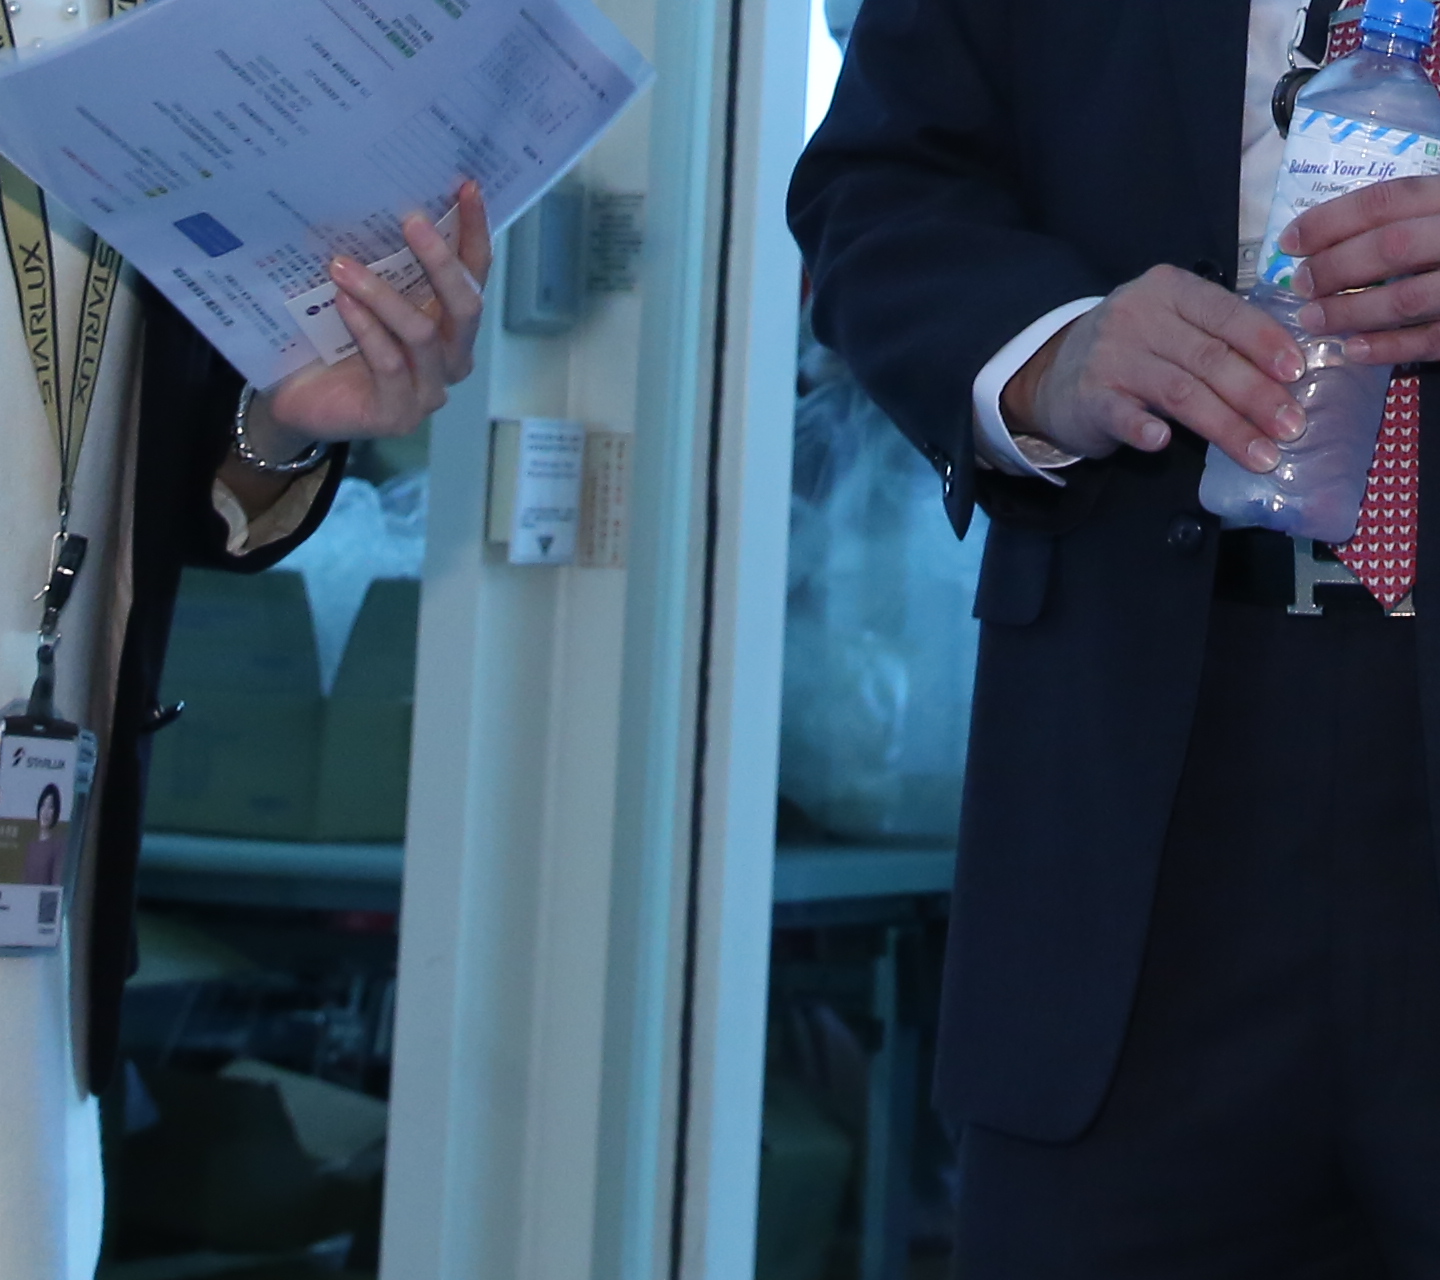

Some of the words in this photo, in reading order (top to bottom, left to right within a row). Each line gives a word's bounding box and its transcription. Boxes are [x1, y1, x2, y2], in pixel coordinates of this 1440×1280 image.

[1289, 158, 1330, 175] Balance
[1331, 159, 1366, 177] Your
[1367, 161, 1397, 182] Life
[18, 240, 53, 406] STARLUX
[75, 241, 116, 404] STARLUX
